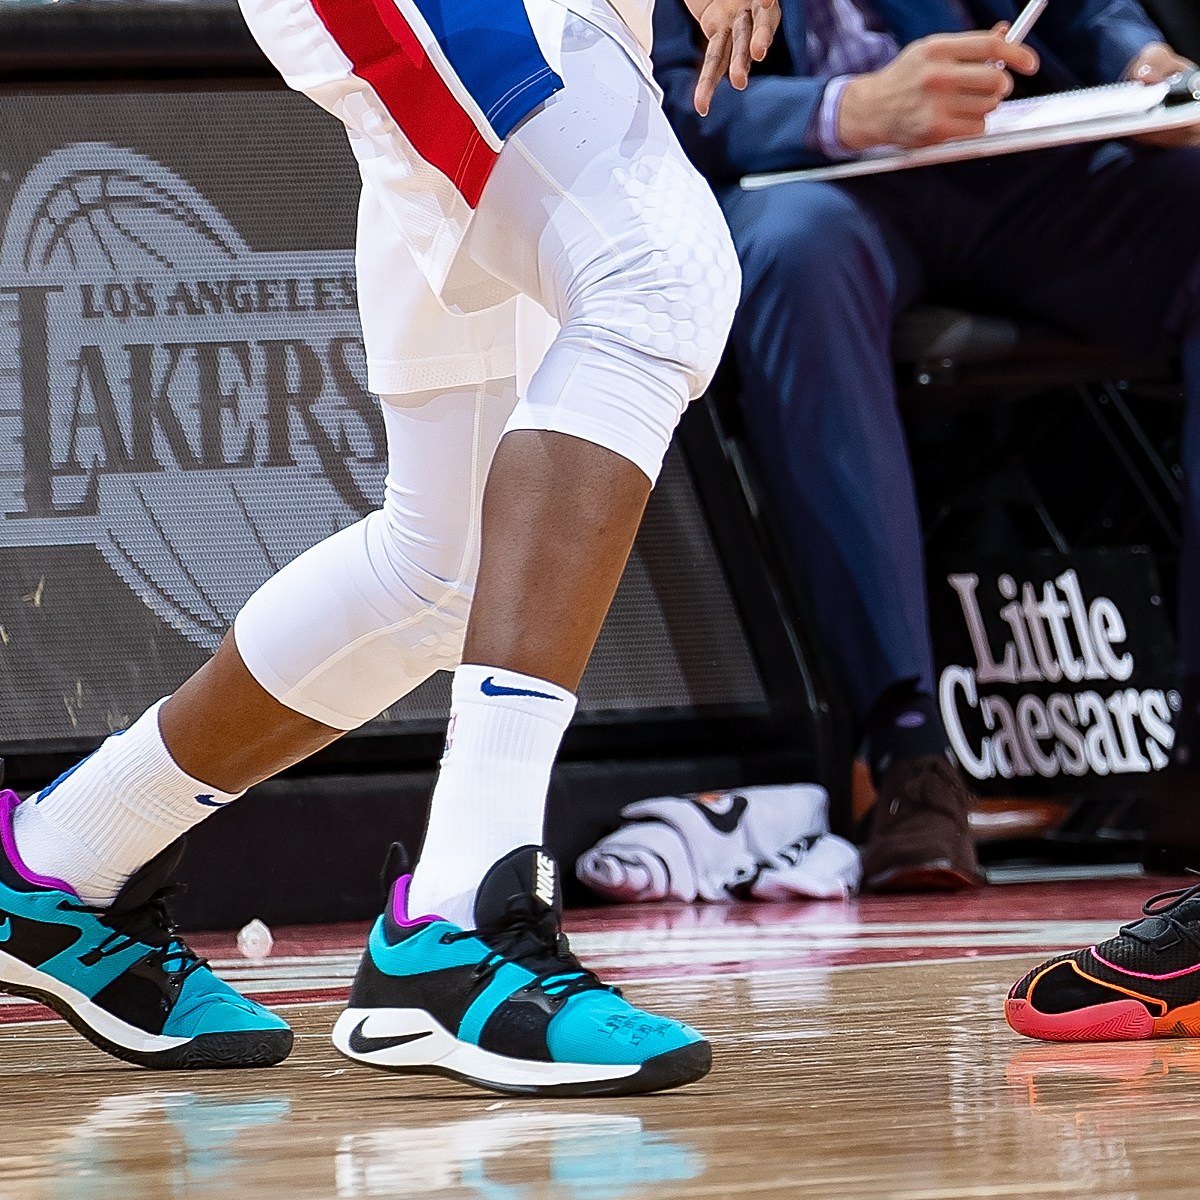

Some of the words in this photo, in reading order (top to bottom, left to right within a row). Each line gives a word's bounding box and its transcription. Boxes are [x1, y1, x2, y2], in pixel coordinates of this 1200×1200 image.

[80, 282, 157, 319] LOS
[0, 285, 388, 520] LAKERS
[947, 568, 1134, 684] Little
[938, 664, 1176, 780] Caesars
[535, 851, 556, 906] NIKE
